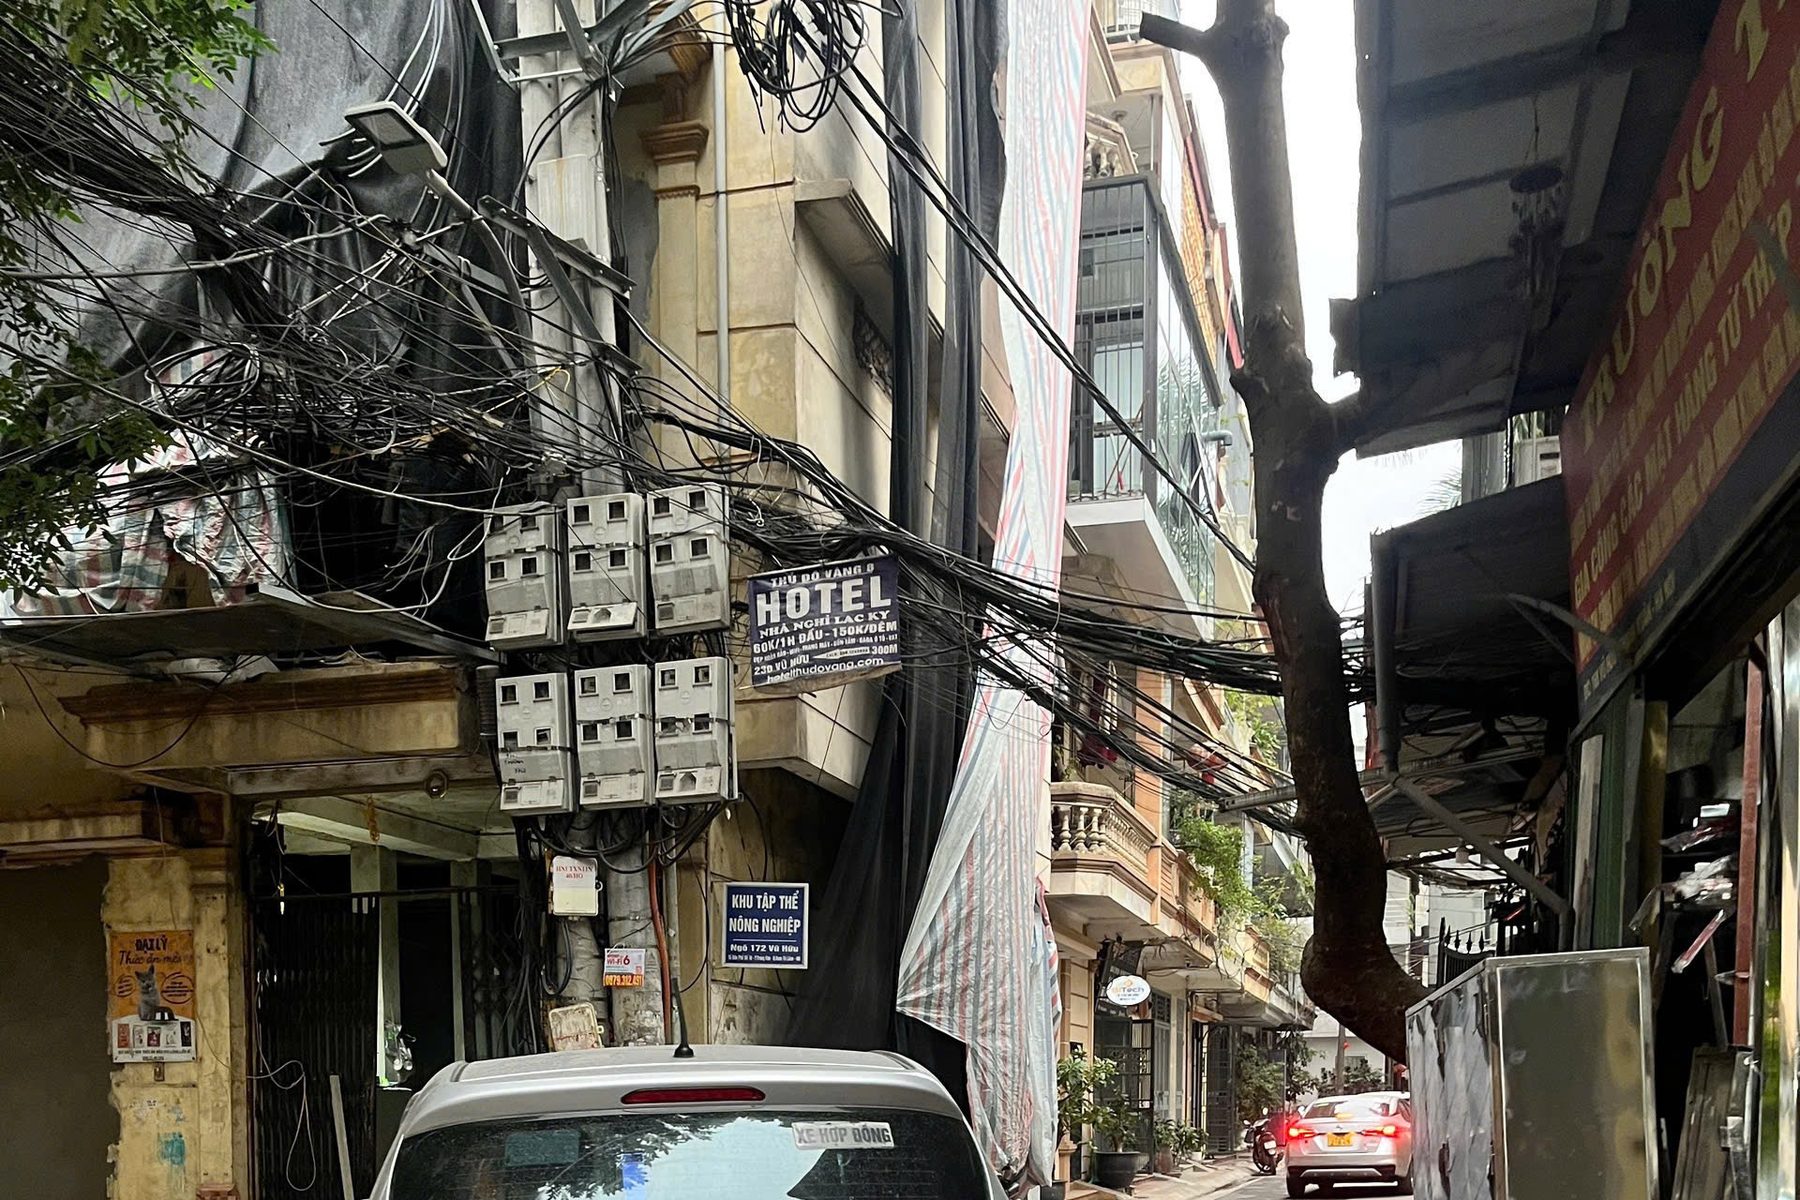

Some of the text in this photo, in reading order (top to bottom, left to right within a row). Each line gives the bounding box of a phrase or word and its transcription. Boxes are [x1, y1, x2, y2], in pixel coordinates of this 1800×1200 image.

[1583, 87, 1724, 449] TRƯỜNG
[756, 575, 892, 627] HOTEL
[759, 622, 790, 639] NHÀ
[753, 635, 796, 654] 60K/1H
[871, 643, 898, 655] 300M
[731, 889, 800, 912] KHU TẬP THỂ
[729, 915, 801, 936] NÔNG NGHIỆP
[730, 944, 748, 953] Ngõ
[750, 944, 767, 952] 172
[795, 1127, 816, 1144] XE
